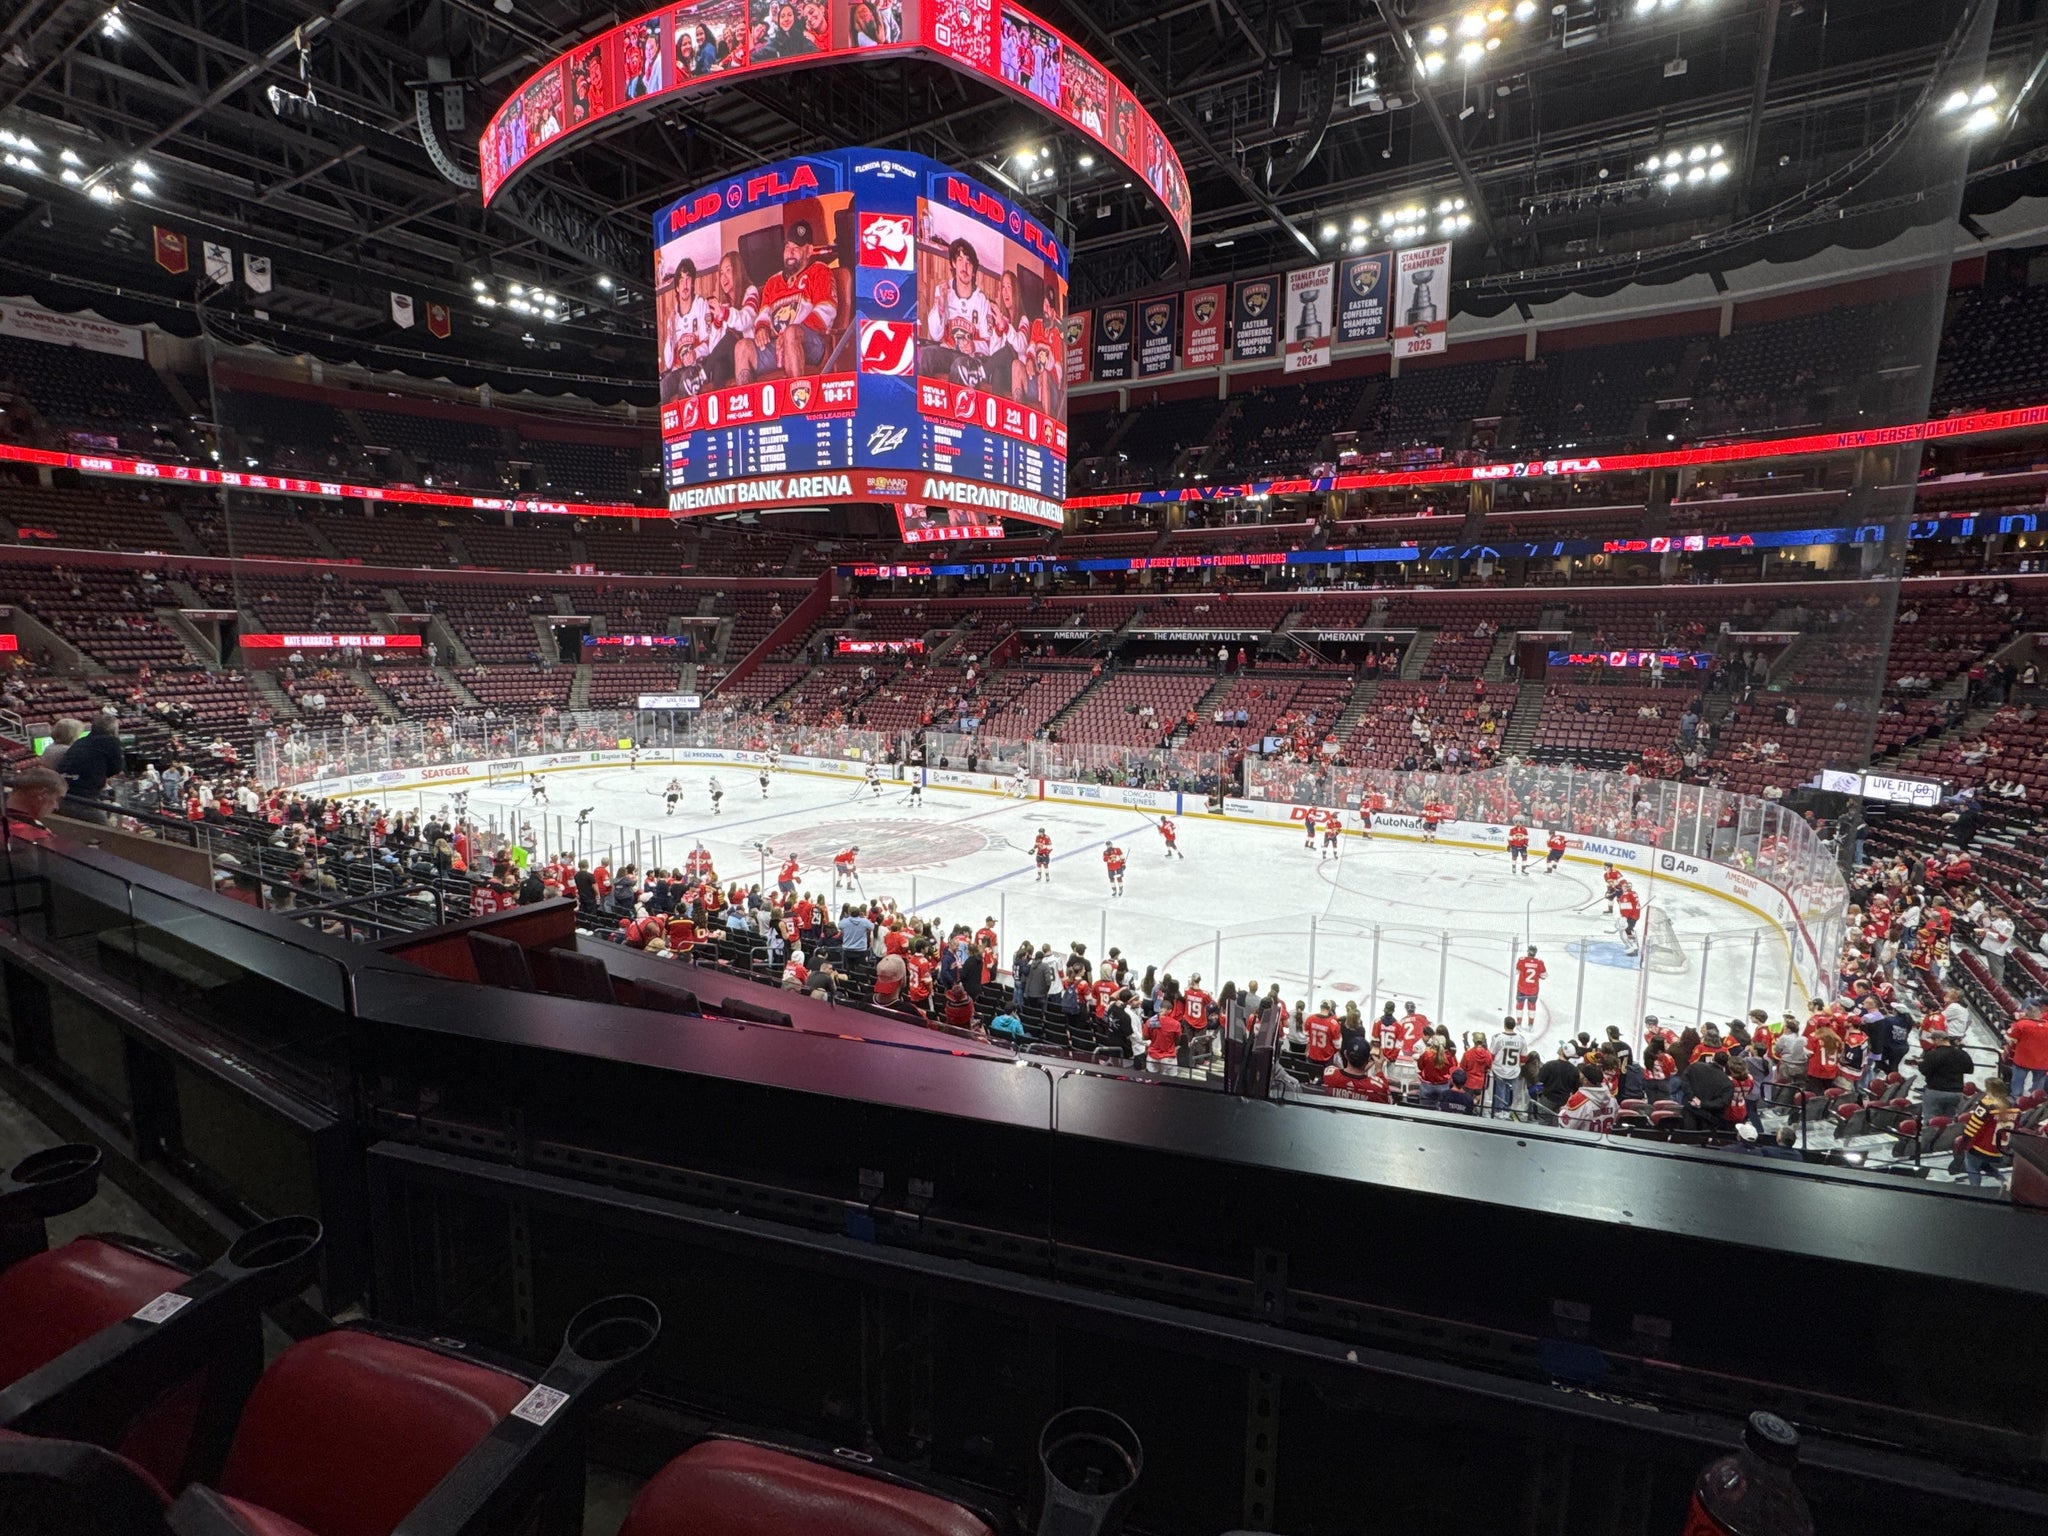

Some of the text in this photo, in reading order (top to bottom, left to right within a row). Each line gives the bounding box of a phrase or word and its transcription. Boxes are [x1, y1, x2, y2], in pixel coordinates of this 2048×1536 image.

[855, 161, 880, 173] FLORIDA
[891, 163, 916, 178] HOCKEY
[670, 192, 721, 230] NJD
[747, 164, 819, 202] FLA
[947, 176, 1005, 224] NJD
[1024, 220, 1059, 265] FLA
[1401, 246, 1447, 263] STANLEY CUP
[1402, 256, 1444, 272] CHAMPIONS
[798, 274, 808, 290] C
[1290, 267, 1331, 283] STANLEY CUP
[1291, 278, 1328, 291] CHAMPIONS
[1348, 298, 1378, 310] EASTERN
[1343, 307, 1383, 320] CONFERENCE
[16, 309, 78, 327] UNRULY
[80, 322, 120, 336] FAN?
[1242, 319, 1268, 330] EASTERN
[1343, 317, 1382, 329] CHAMPIONS
[1192, 327, 1216, 337] ATLANTIC
[1237, 327, 1273, 339] CONFERENCE
[1348, 327, 1375, 338] 2024-25
[1097, 342, 1130, 352] PRESIDENTS'
[1145, 337, 1168, 346] EASTERN
[1192, 336, 1215, 346] DIVISION
[1237, 336, 1272, 347] CHAMPIONS
[1407, 339, 1432, 353] 2025
[1103, 352, 1123, 361] TROPHY
[1142, 344, 1172, 356] CONFERENCE
[1188, 344, 1219, 355] CHAMPIONS
[1241, 346, 1266, 356] 2023-24
[1142, 353, 1170, 365] CHAMPIONS
[1296, 354, 1318, 367] 2024
[822, 380, 855, 389] PANTHERS
[922, 385, 945, 396] DEVILS
[729, 393, 749, 411] 2:24
[762, 384, 775, 416] 0
[707, 395, 718, 425] 0
[824, 411, 856, 419] LEADERS
[986, 398, 997, 428] 0
[1005, 408, 1021, 425] 2:24
[1028, 411, 1037, 440] 0
[1837, 434, 1866, 447] NEW
[1871, 425, 1926, 444] JERSEY
[1927, 418, 1975, 436] DEVILS
[866, 424, 908, 455] FLA
[1472, 460, 1602, 478] NJD FLA
[669, 474, 852, 511] AMERANT BANK ARENA
[472, 498, 568, 513] NJD FLA
[922, 478, 1064, 524] AMERANT BANK ARENA
[1603, 535, 1754, 552] NJD FLA
[1130, 558, 1146, 569] NEW
[1148, 557, 1175, 568] JERSEY
[1176, 556, 1201, 567] DEVILS
[1213, 554, 1244, 566] FLORIDA
[1246, 553, 1286, 565] PANTHERS
[854, 567, 932, 576] NJD FLA
[653, 637, 677, 645] FLA
[1053, 631, 1090, 639] AMERANT
[1153, 632, 1241, 641] THE AMERANT VAULT
[1317, 632, 1366, 641] AMERANT
[421, 766, 470, 779] SEATGEEK
[1122, 789, 1156, 798] COMCAST
[1122, 797, 1156, 806] BUSINESS
[1583, 842, 1637, 860] AMAZING
[1725, 871, 1759, 890] AMERANT
[1733, 886, 1749, 898] BANK
[1525, 968, 1536, 983] 2
[1187, 1000, 1202, 1018] 19
[1404, 1022, 1416, 1040] 2
[1311, 1030, 1327, 1049] 13
[1380, 1031, 1395, 1049] 16
[1502, 1048, 1520, 1066] 15
